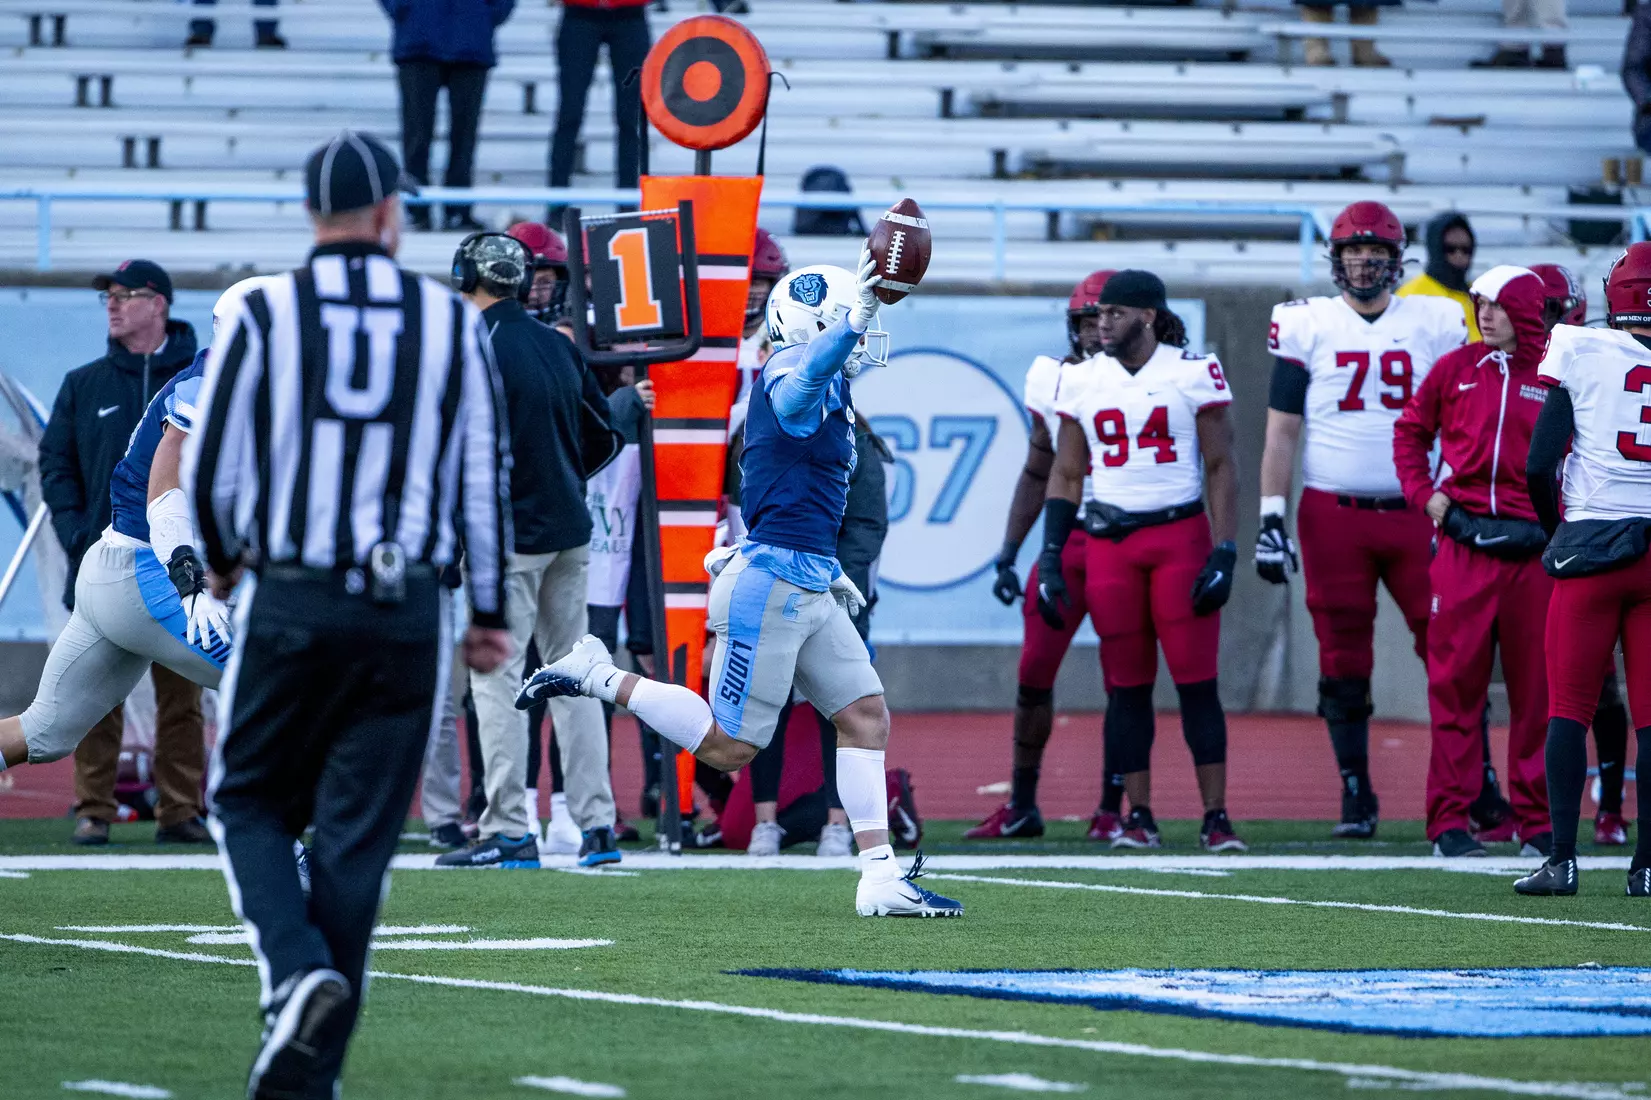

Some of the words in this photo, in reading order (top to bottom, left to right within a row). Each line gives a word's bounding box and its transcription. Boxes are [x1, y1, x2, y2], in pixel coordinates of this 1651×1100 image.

[608, 227, 663, 331] 1
[320, 303, 405, 419] U
[1336, 350, 1413, 411] 79
[1094, 406, 1178, 467] 94
[720, 639, 753, 706] LIONS
